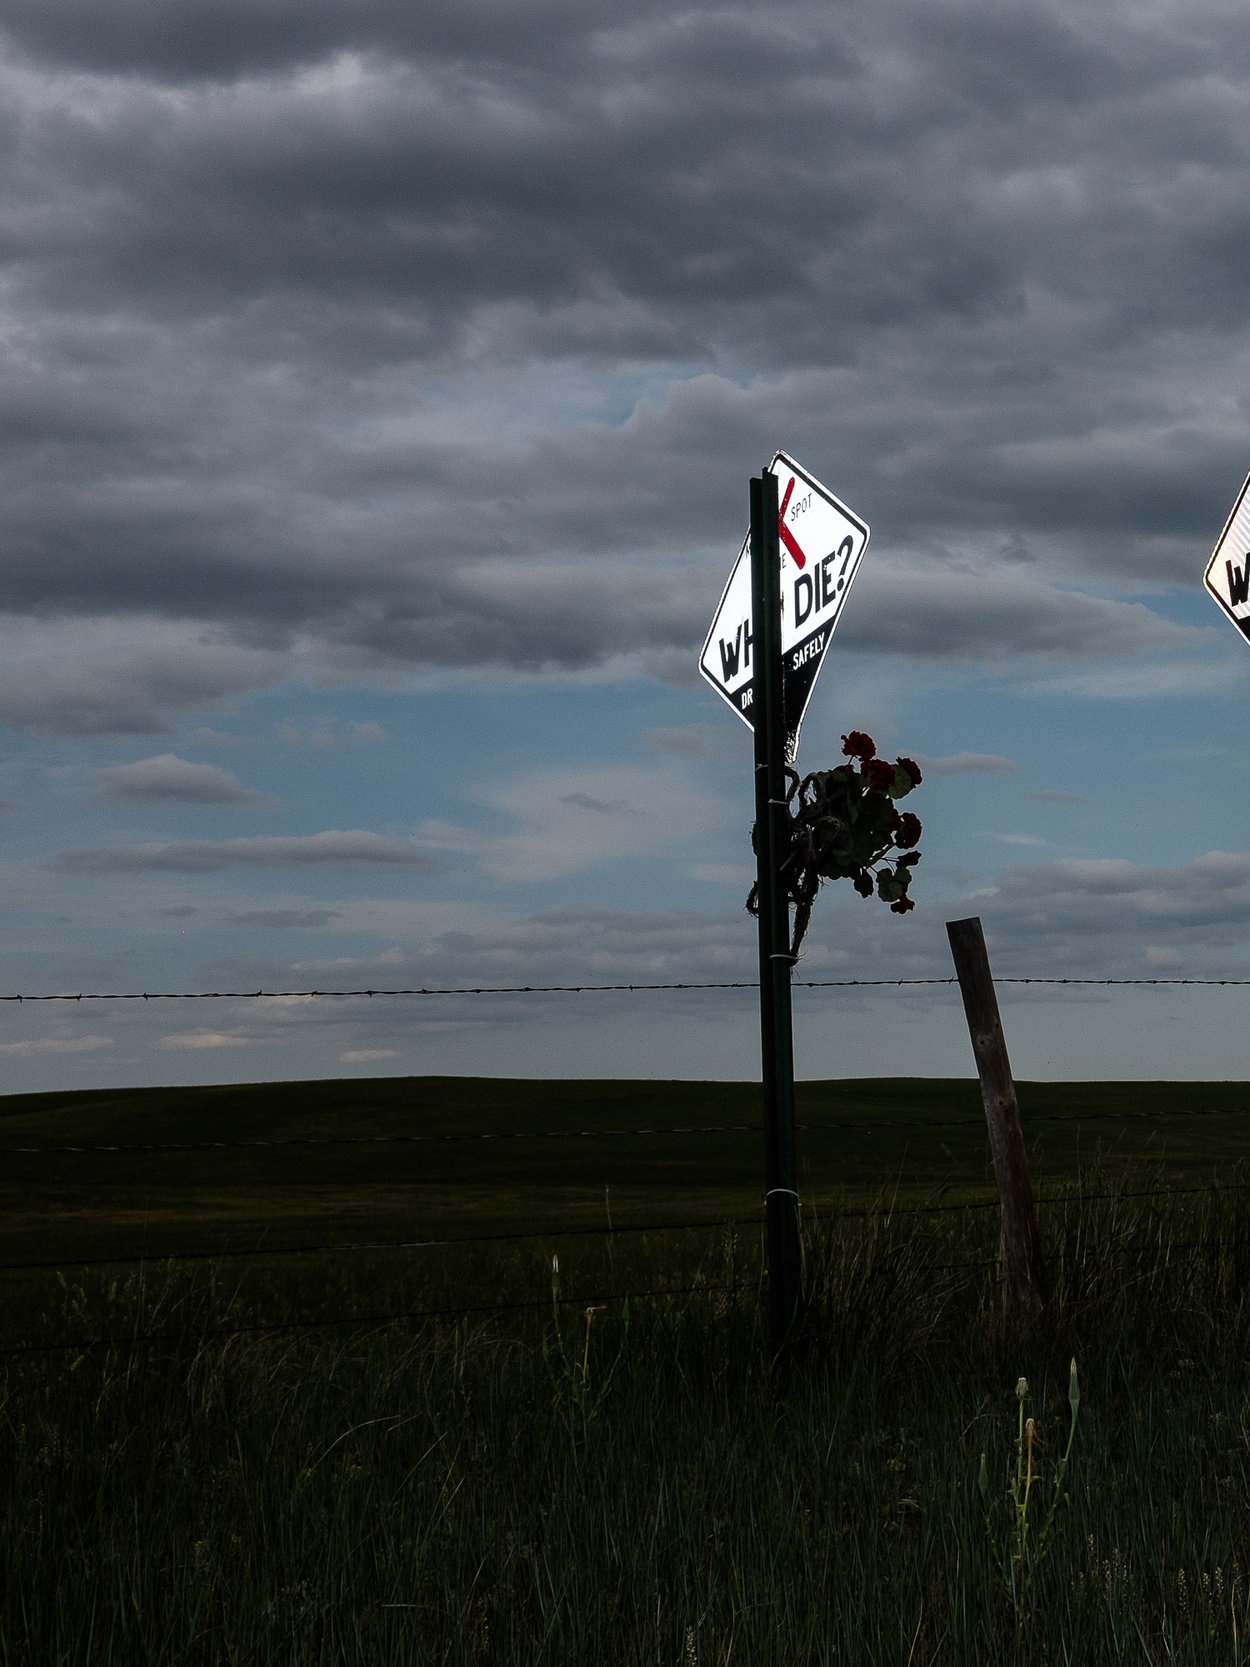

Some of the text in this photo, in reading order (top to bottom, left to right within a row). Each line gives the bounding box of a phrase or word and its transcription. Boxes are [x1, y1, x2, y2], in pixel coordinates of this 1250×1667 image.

[790, 493, 812, 521] SPOT
[719, 534, 854, 683] WH DIE?
[792, 632, 825, 671] SAFELY
